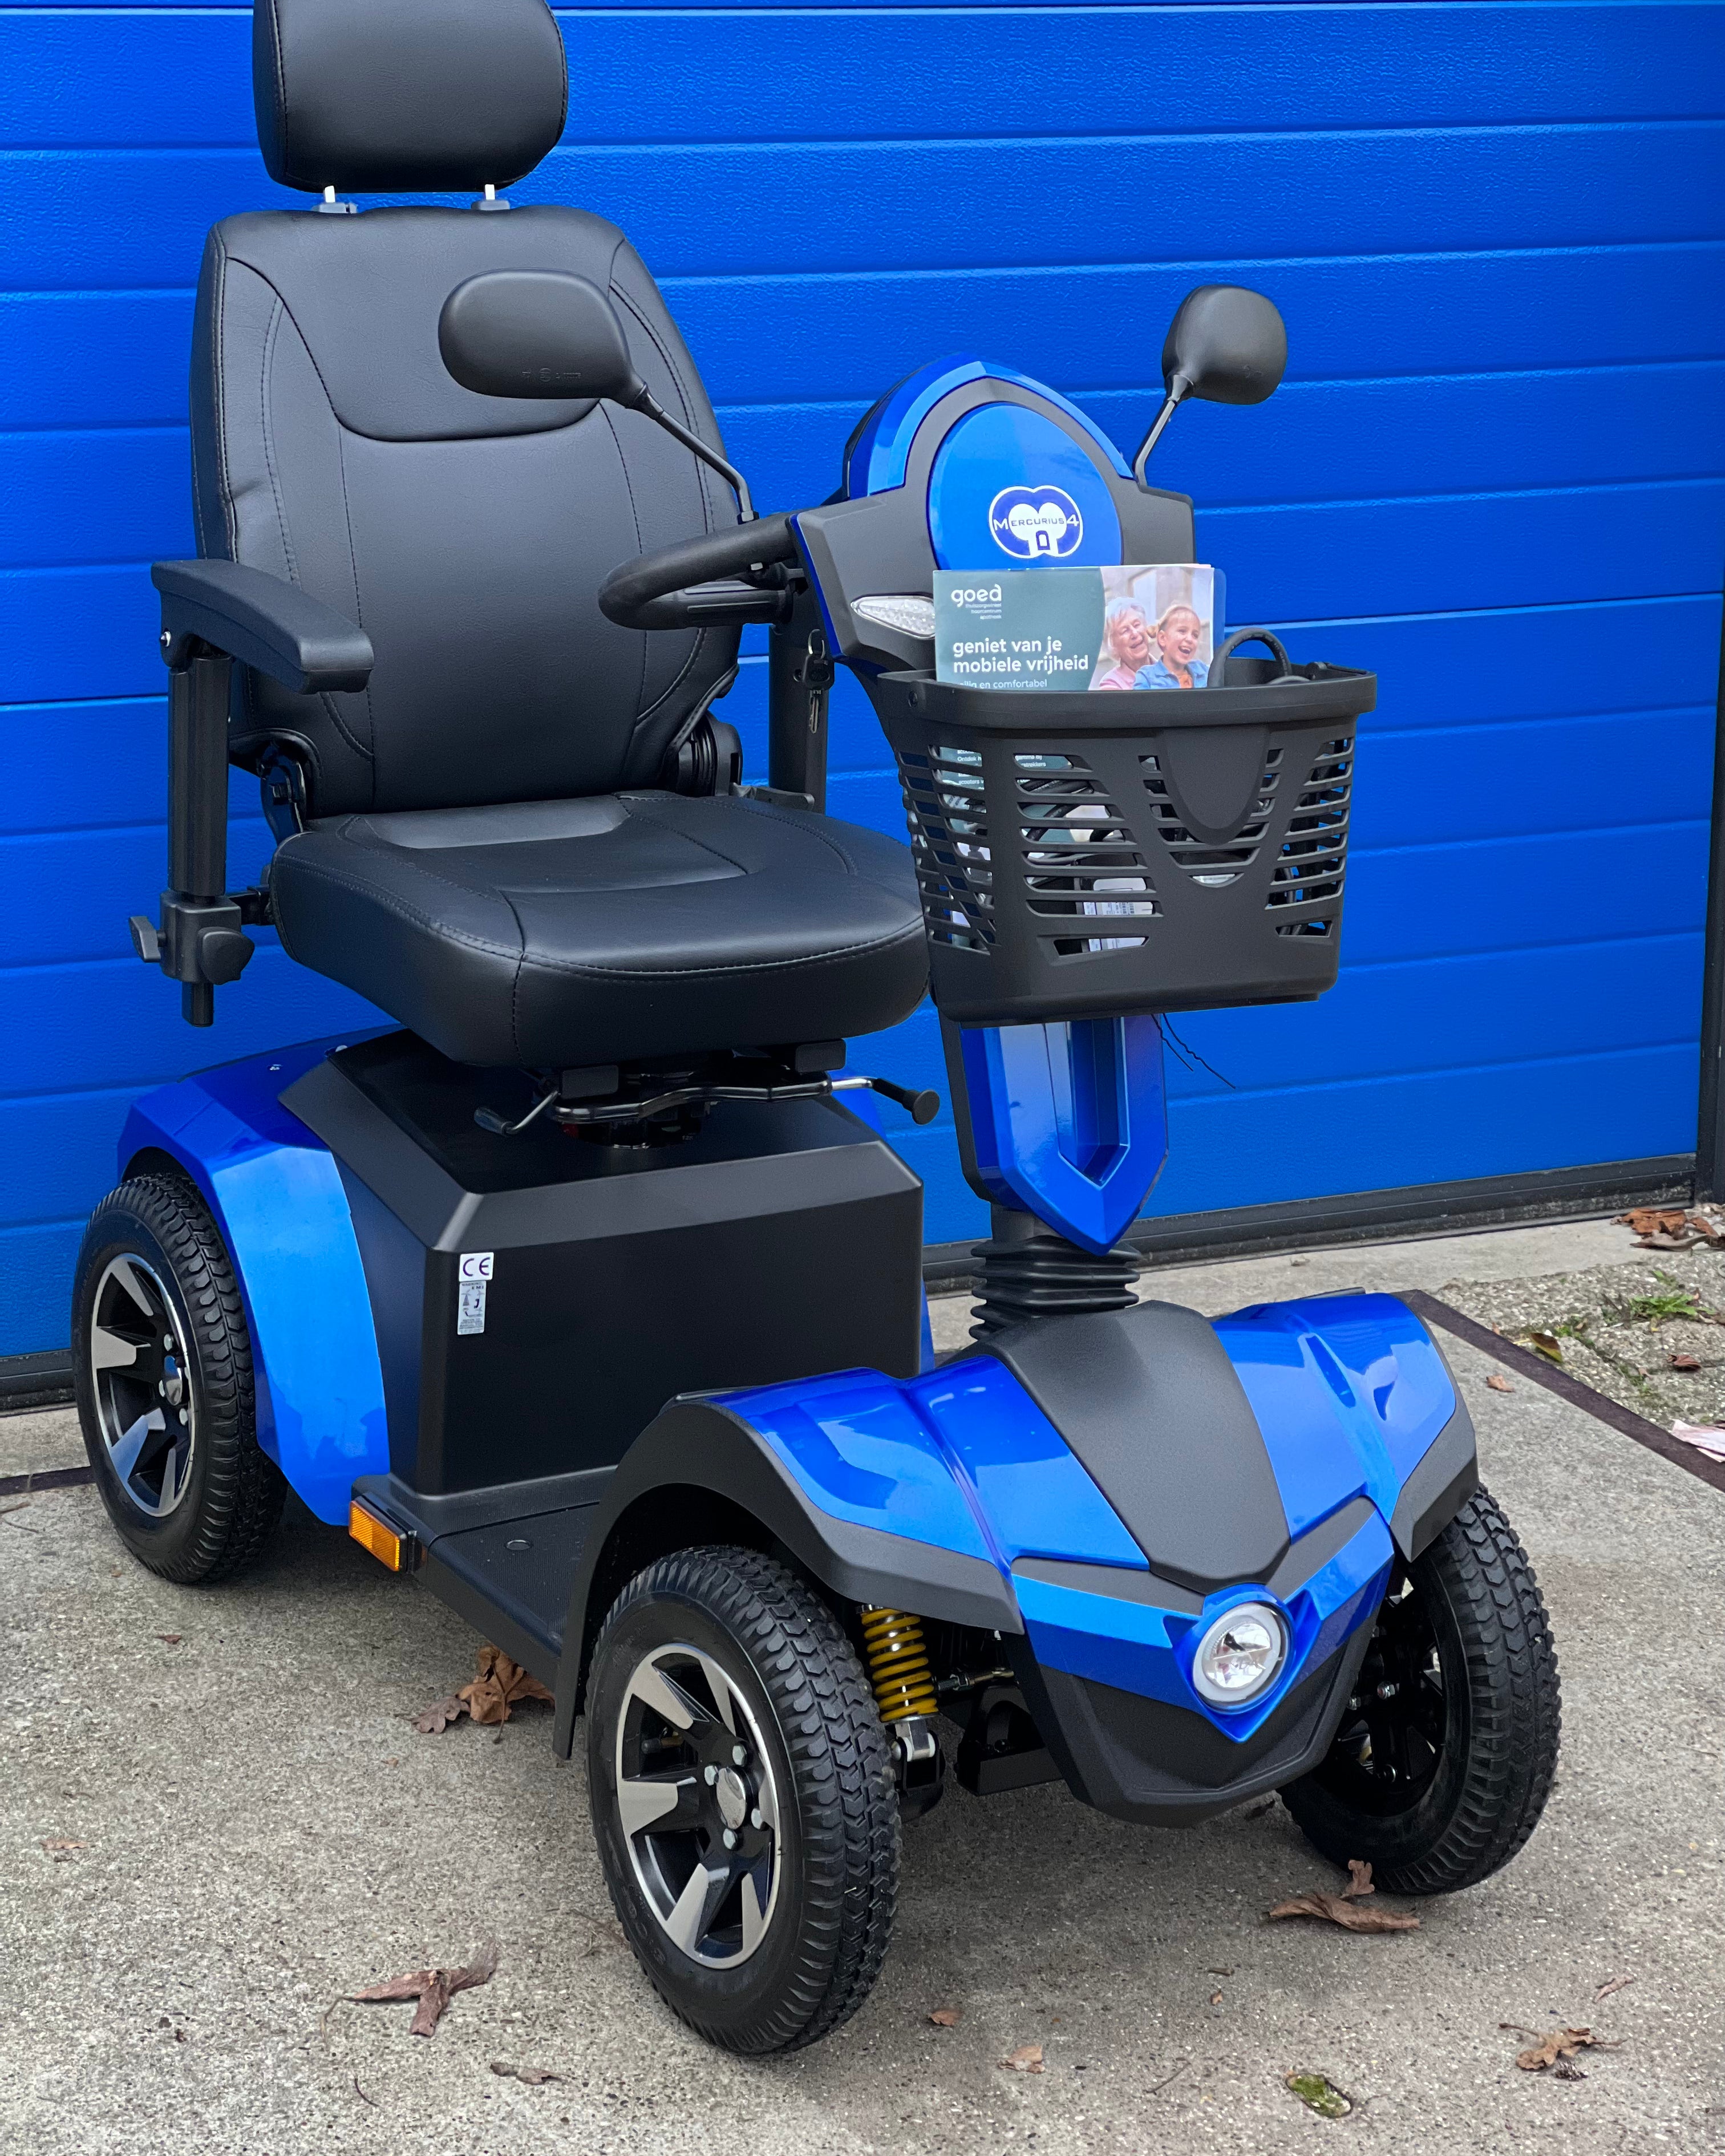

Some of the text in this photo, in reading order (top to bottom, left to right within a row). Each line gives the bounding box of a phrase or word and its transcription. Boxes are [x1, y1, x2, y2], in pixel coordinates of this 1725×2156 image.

[951, 583, 1002, 607] goed
[953, 635, 1062, 657] geniet van je
[954, 655, 1088, 675] mobiele vrijheid
[993, 679, 1047, 688] comfortabel
[463, 1257, 491, 1276] CE
